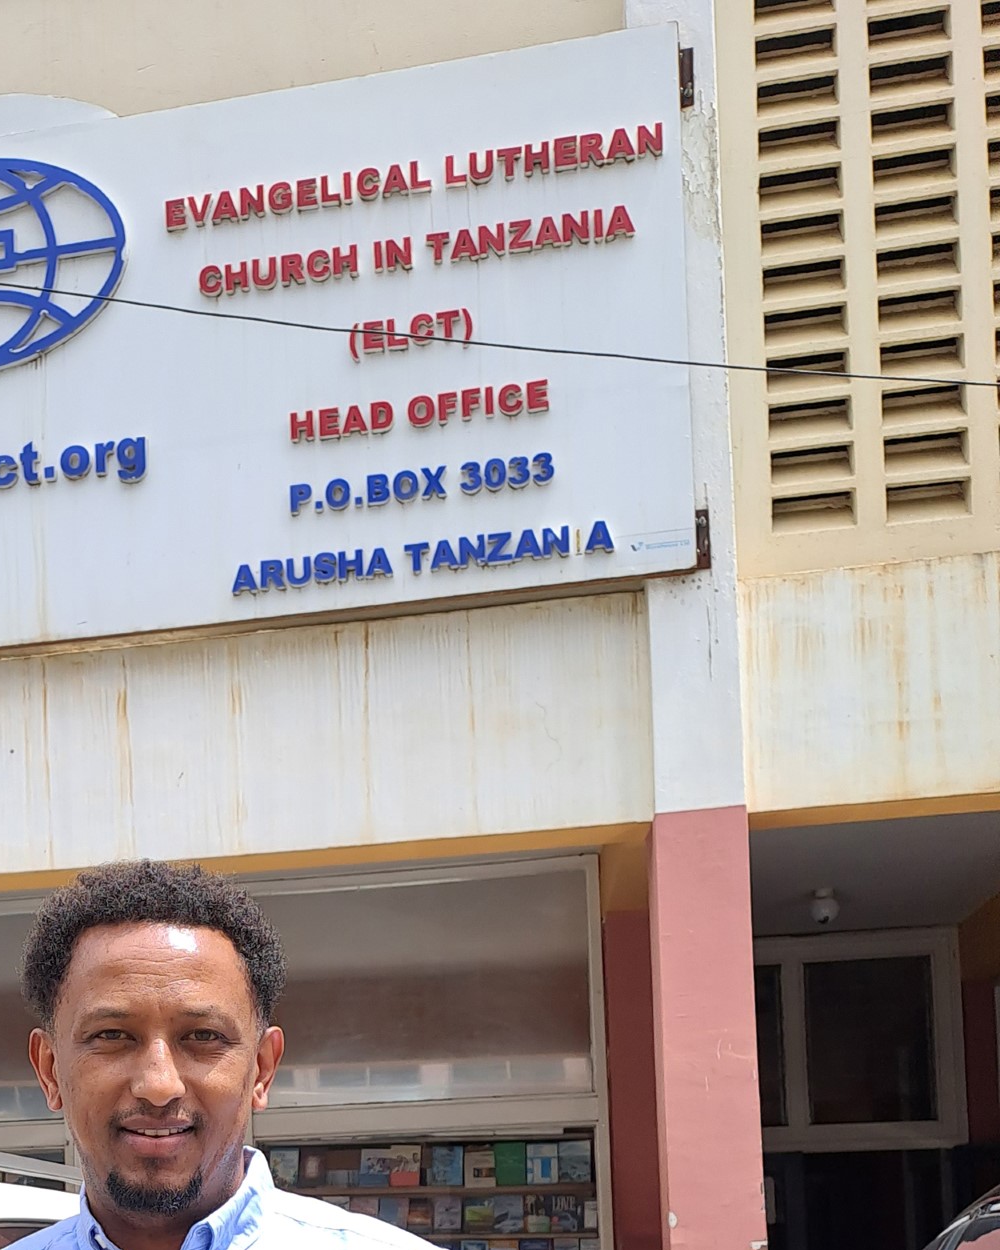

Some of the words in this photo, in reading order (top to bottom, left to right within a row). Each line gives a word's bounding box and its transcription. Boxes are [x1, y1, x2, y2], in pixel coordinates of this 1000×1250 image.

[165, 161, 431, 231] EVANGELICAL
[445, 123, 663, 187] LUTHERAN
[199, 244, 358, 296] CHURCH
[373, 236, 413, 272] IN
[425, 205, 635, 264] TANZANIA
[348, 308, 473, 361] (ELCT)
[289, 400, 394, 442] HEAD
[406, 379, 549, 428] OFFICE
[289, 464, 446, 513] P.O.BOX
[460, 451, 555, 493] 3033
[231, 546, 393, 594] ARUSHA
